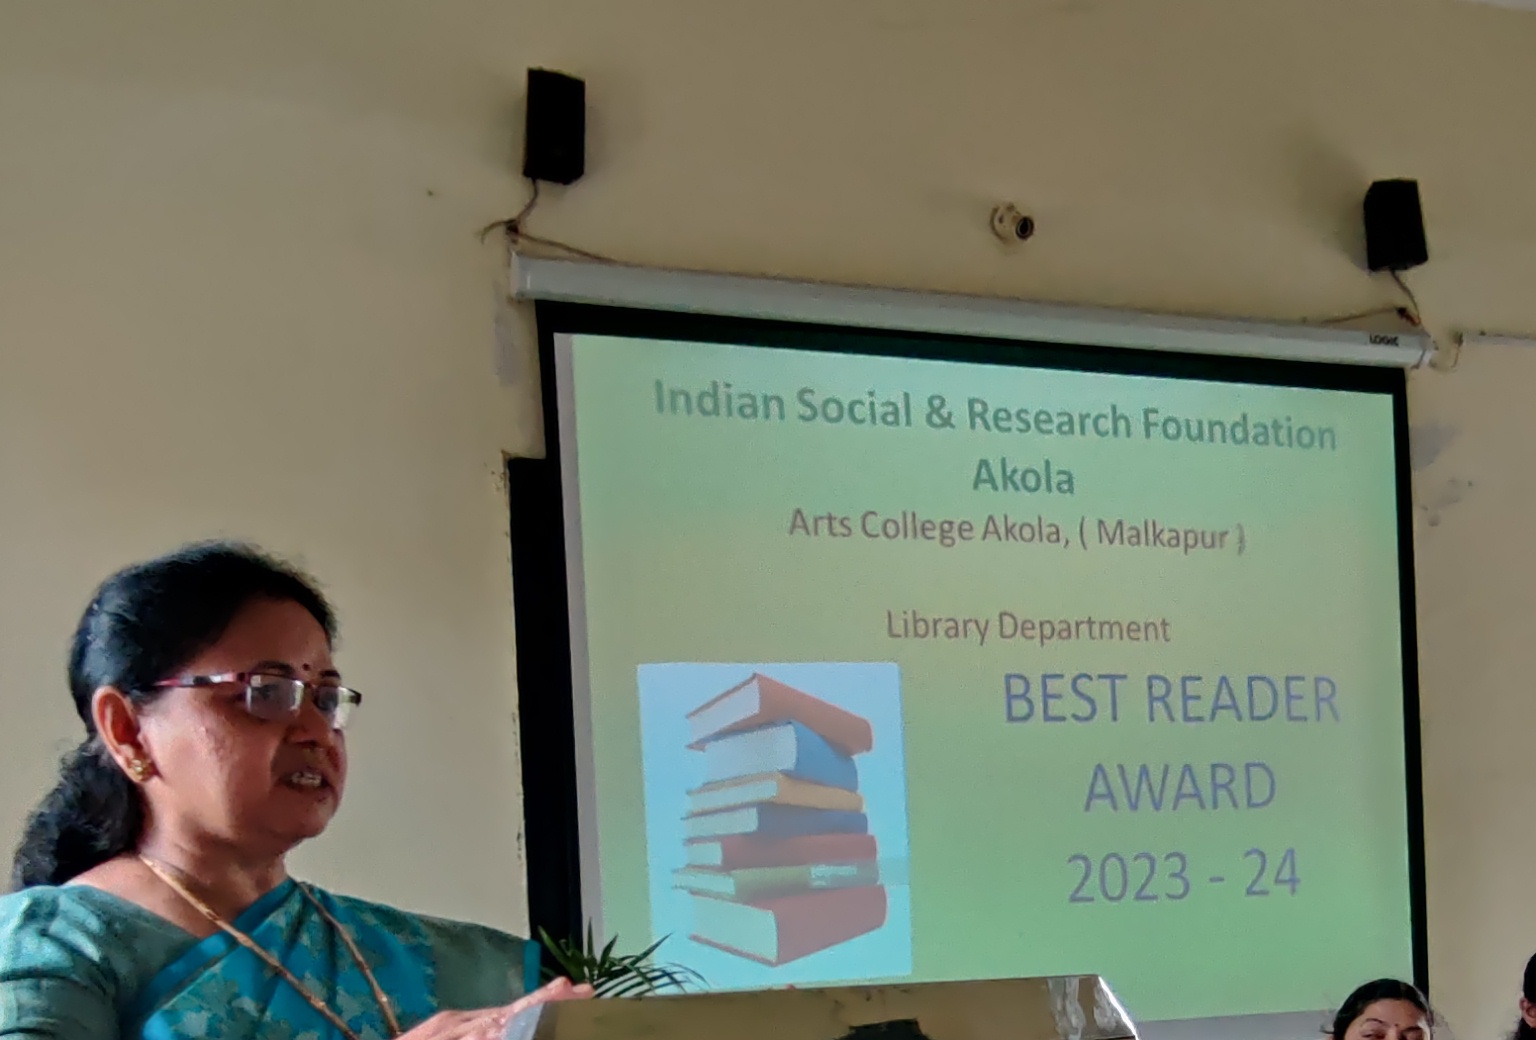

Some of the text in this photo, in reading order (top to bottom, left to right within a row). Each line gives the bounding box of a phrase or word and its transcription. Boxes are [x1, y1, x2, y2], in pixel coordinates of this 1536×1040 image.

[654, 378, 1336, 451] Indian Social & Research Foundation
[972, 457, 1075, 495] Akola
[789, 508, 852, 538] Arts
[860, 511, 974, 548] College
[982, 514, 1070, 551] Akola,
[886, 610, 1171, 647] Library Department
[1004, 673, 1341, 724] BEST READER
[1084, 762, 1277, 812] AWARD
[1067, 852, 1191, 903] 2023
[1244, 848, 1301, 897] 24
